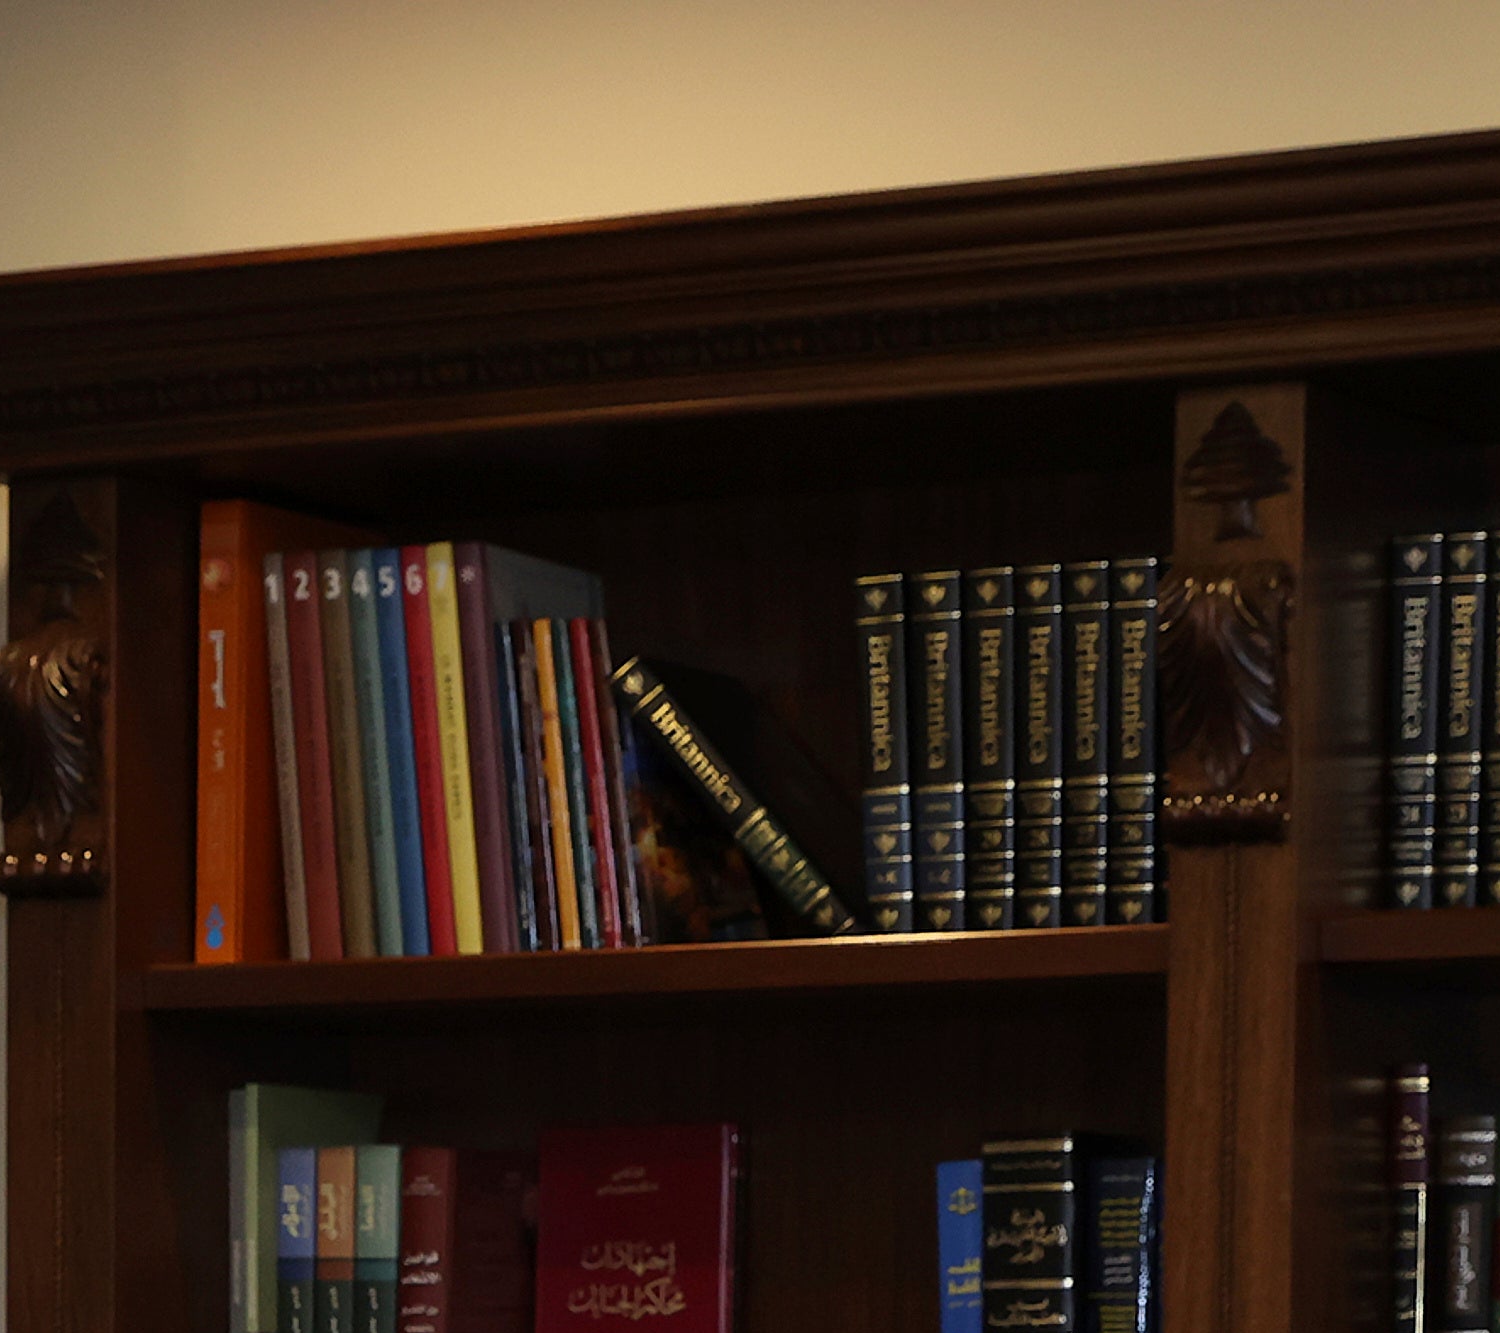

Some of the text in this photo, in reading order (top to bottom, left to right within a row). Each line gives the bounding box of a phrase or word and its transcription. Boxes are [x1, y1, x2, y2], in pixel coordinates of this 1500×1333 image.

[265, 574, 278, 603] 1
[293, 569, 310, 600] 2
[324, 567, 341, 600] 3
[352, 568, 369, 598] 4
[378, 566, 395, 597] 5
[406, 564, 423, 595] 6
[868, 634, 893, 772] Britannica
[924, 631, 950, 770] Britannica
[979, 629, 1002, 766] Britannica
[1028, 626, 1053, 765] Britannica
[1075, 622, 1101, 761] Britannica
[1121, 620, 1146, 759] Britannica
[1400, 596, 1430, 739] Britannica
[1448, 595, 1478, 737] Britannica
[649, 700, 744, 814] Britannica
